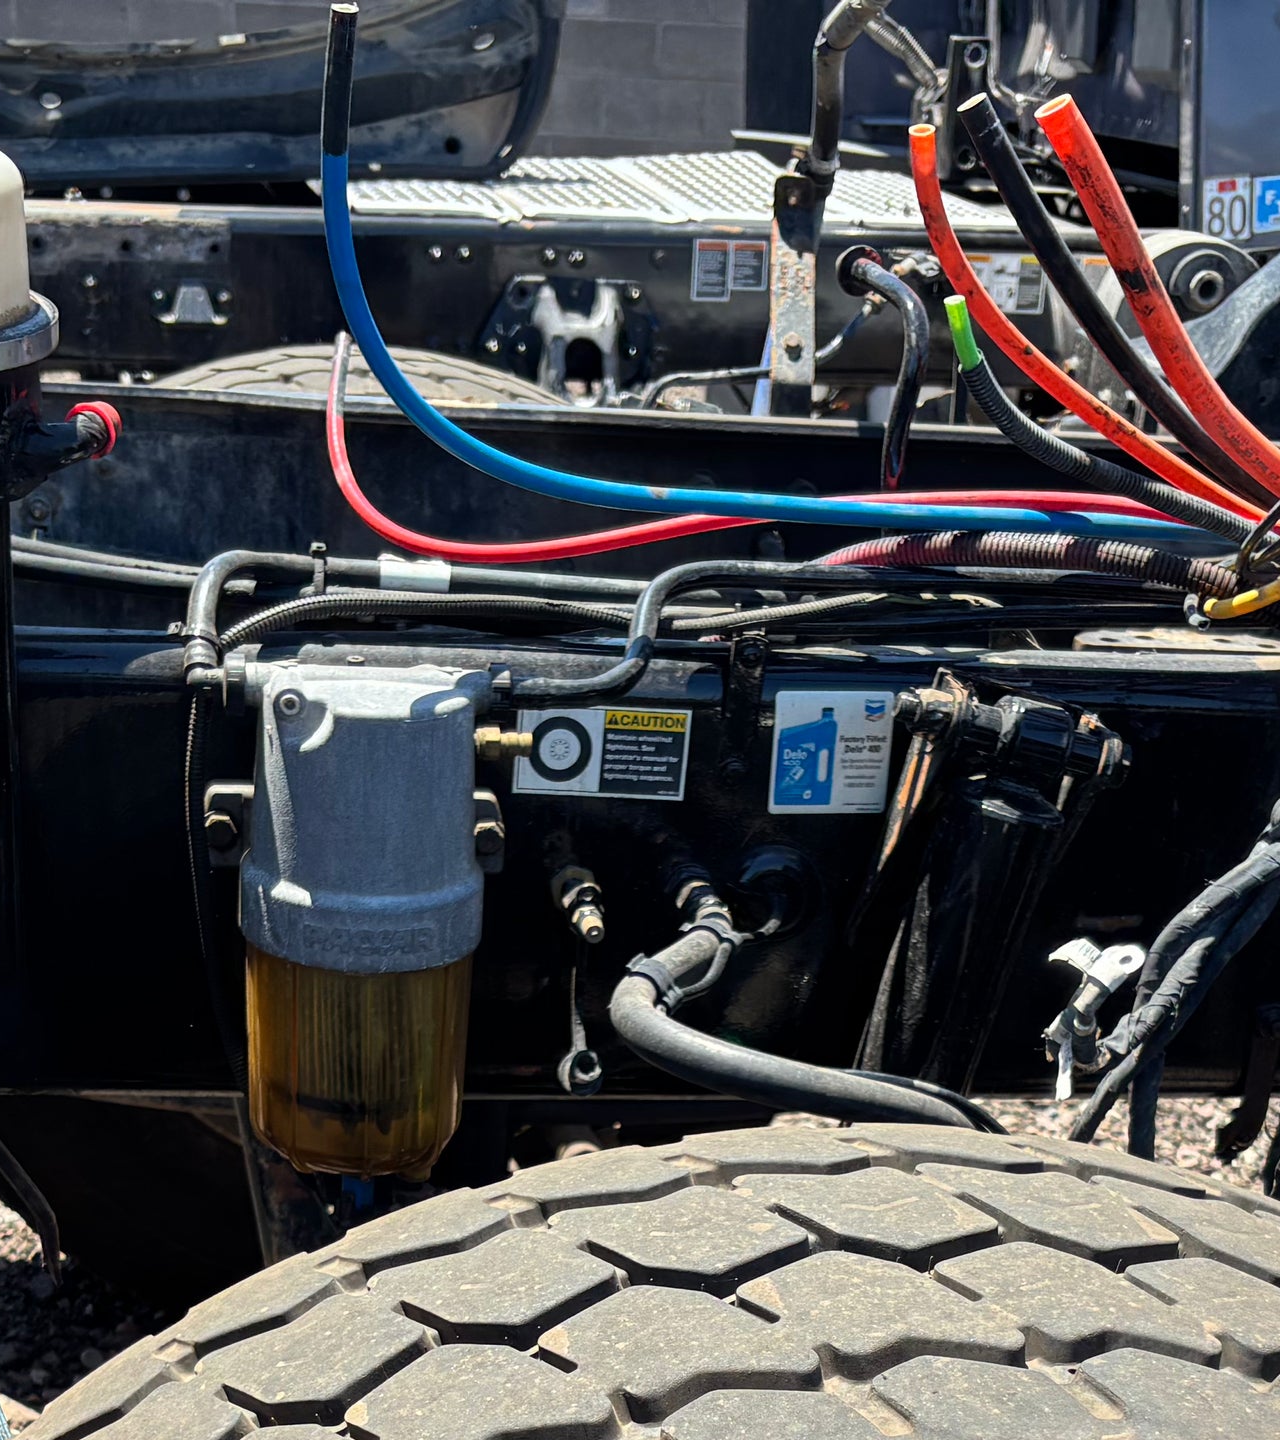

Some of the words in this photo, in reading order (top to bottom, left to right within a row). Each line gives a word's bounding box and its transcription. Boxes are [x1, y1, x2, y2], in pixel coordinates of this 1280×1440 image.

[1208, 195, 1247, 237] 80
[620, 713, 686, 729] CAUTION
[783, 749, 808, 760] Delo
